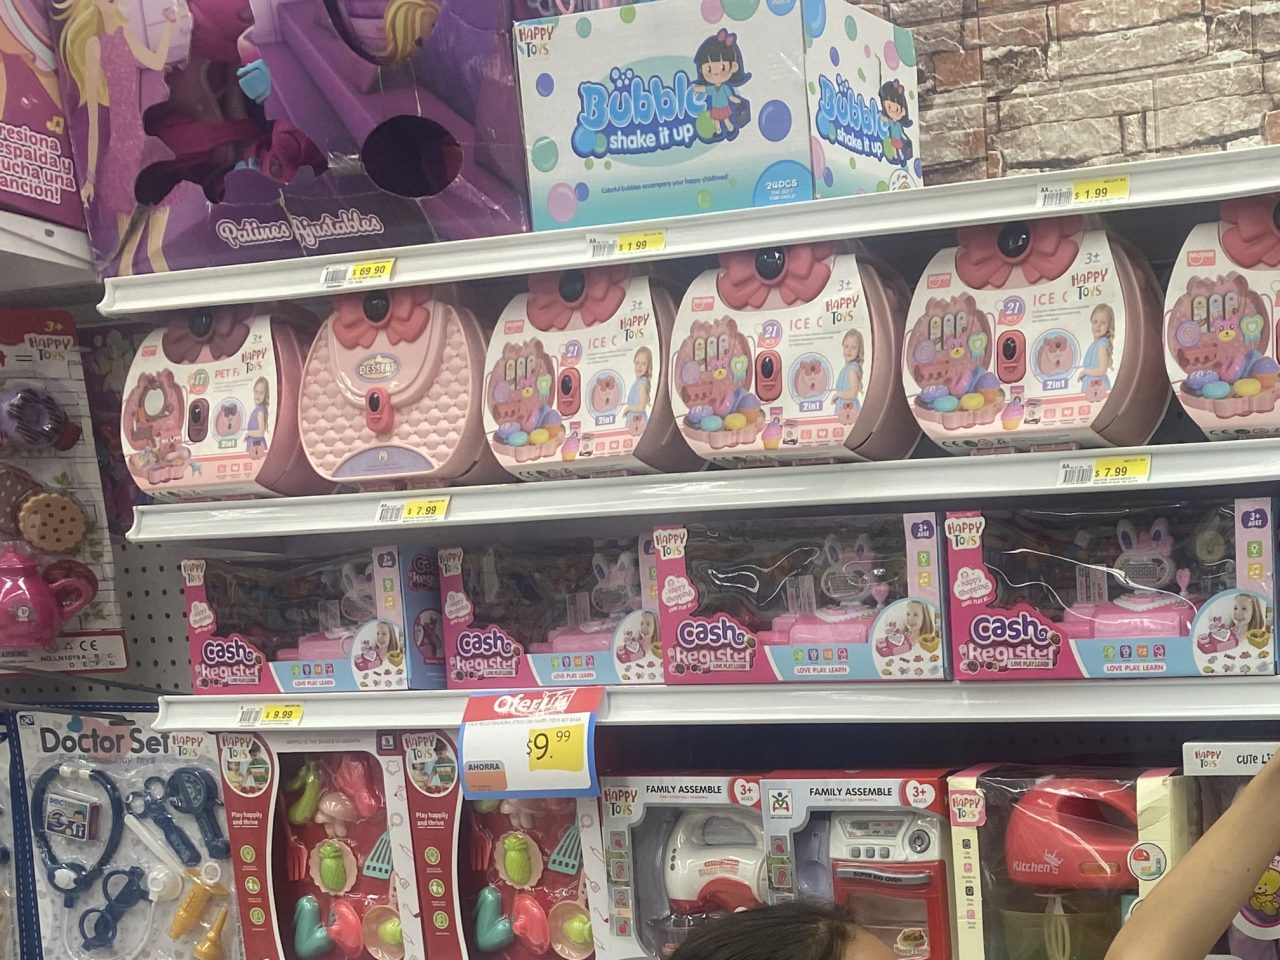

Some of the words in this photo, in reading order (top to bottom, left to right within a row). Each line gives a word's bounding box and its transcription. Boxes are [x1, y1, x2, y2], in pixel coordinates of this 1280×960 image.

[518, 26, 554, 44] HAPPY
[580, 68, 707, 130] Bubble
[609, 131, 656, 149] shake
[659, 127, 669, 145] it
[674, 124, 694, 143] up
[1085, 188, 1109, 199] 1.99
[218, 219, 291, 247] Patines
[293, 210, 383, 247] Ajustables
[359, 265, 386, 277] 69.90
[360, 363, 397, 376] DESSERT
[39, 727, 125, 754] Doctor
[468, 763, 500, 772] AHORRA
[646, 785, 676, 794] FAMILY
[678, 785, 722, 794] ASSEMBLE
[232, 811, 241, 819] Play
[243, 811, 263, 820] happily
[1012, 862, 1050, 874] Kitchen
